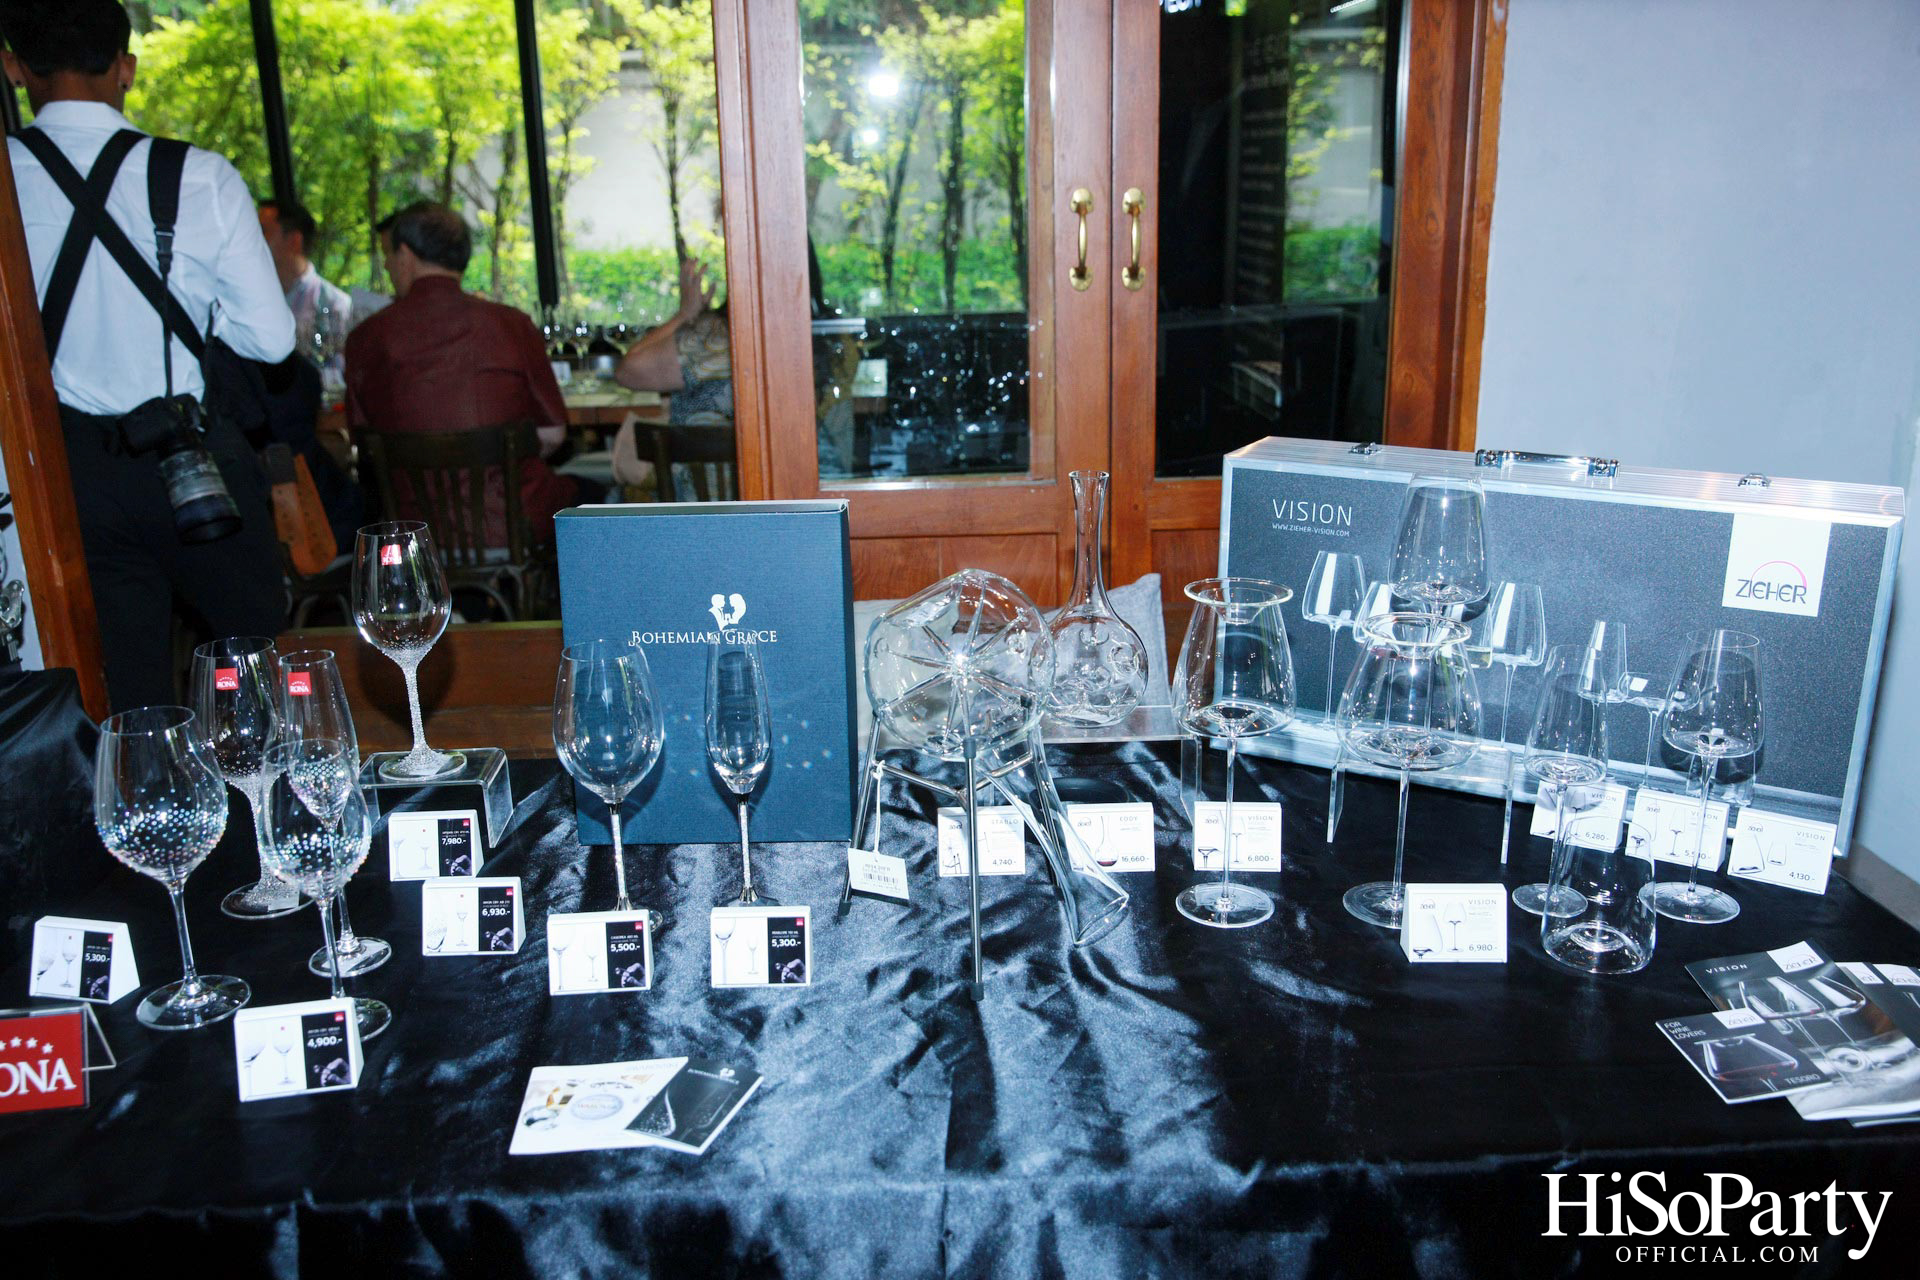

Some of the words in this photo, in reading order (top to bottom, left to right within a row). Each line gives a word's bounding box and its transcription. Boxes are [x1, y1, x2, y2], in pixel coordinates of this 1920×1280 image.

[1272, 498, 1352, 527] VISION
[1271, 522, 1350, 537] WWW.ZIEHER-VISION.COM
[1735, 578, 1807, 604] ZIEHER
[631, 630, 720, 645] BOHEMIAN
[1705, 963, 1749, 974] VISION
[1664, 1021, 1683, 1029] FOR
[1669, 1027, 1691, 1035] WINE
[1674, 1030, 1707, 1040] LOVERS
[0, 1057, 77, 1098] ONA
[1783, 1073, 1821, 1084] TESORO
